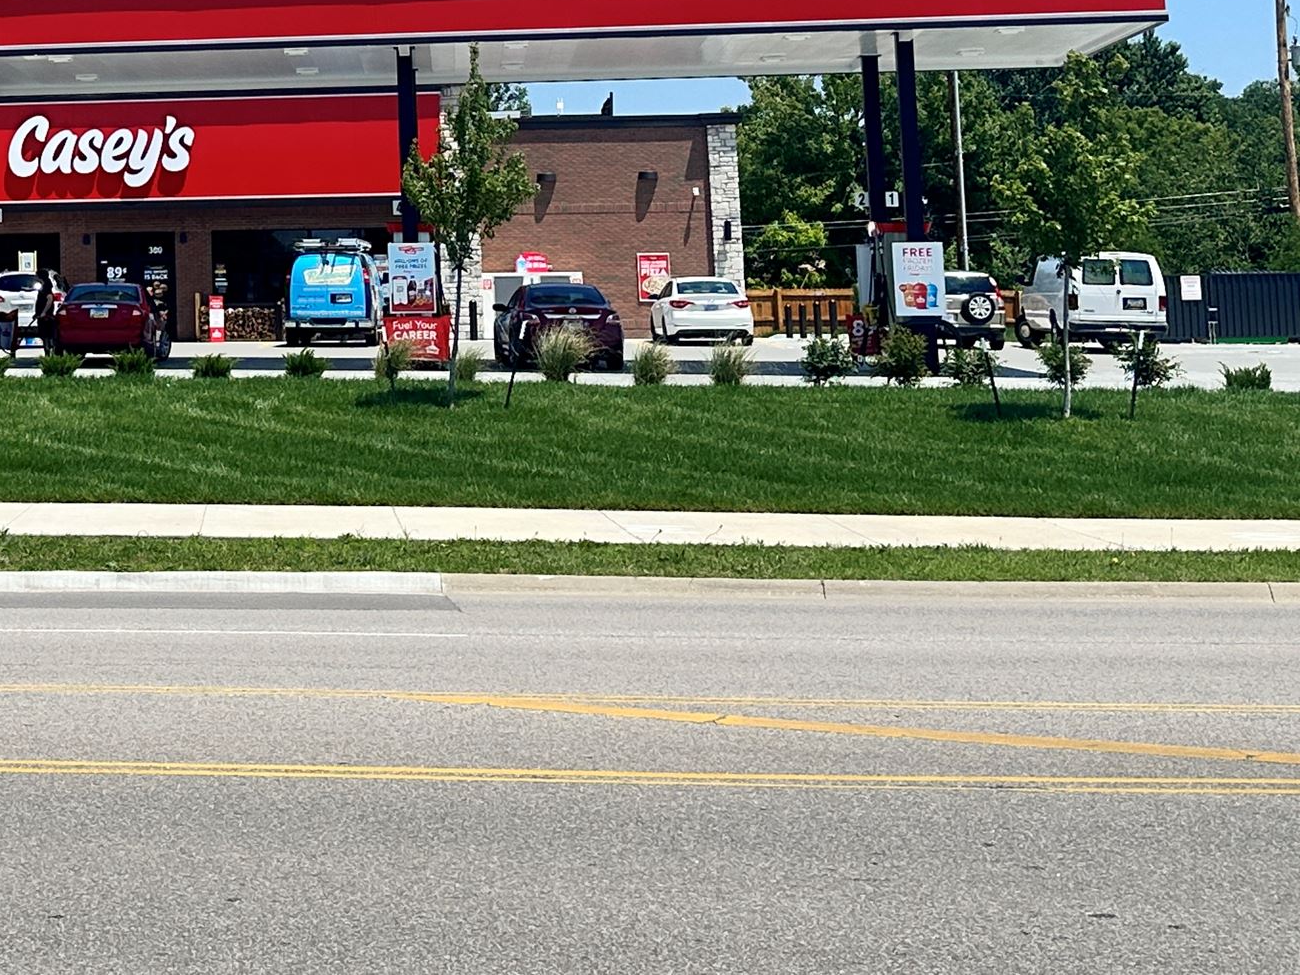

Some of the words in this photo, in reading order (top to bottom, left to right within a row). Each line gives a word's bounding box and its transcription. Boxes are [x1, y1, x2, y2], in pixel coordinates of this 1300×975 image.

[8, 115, 195, 188] Casey's
[902, 247, 933, 257] FREE
[392, 320, 413, 331] Fuel
[414, 319, 438, 330] Your
[393, 330, 437, 341] CAREER
